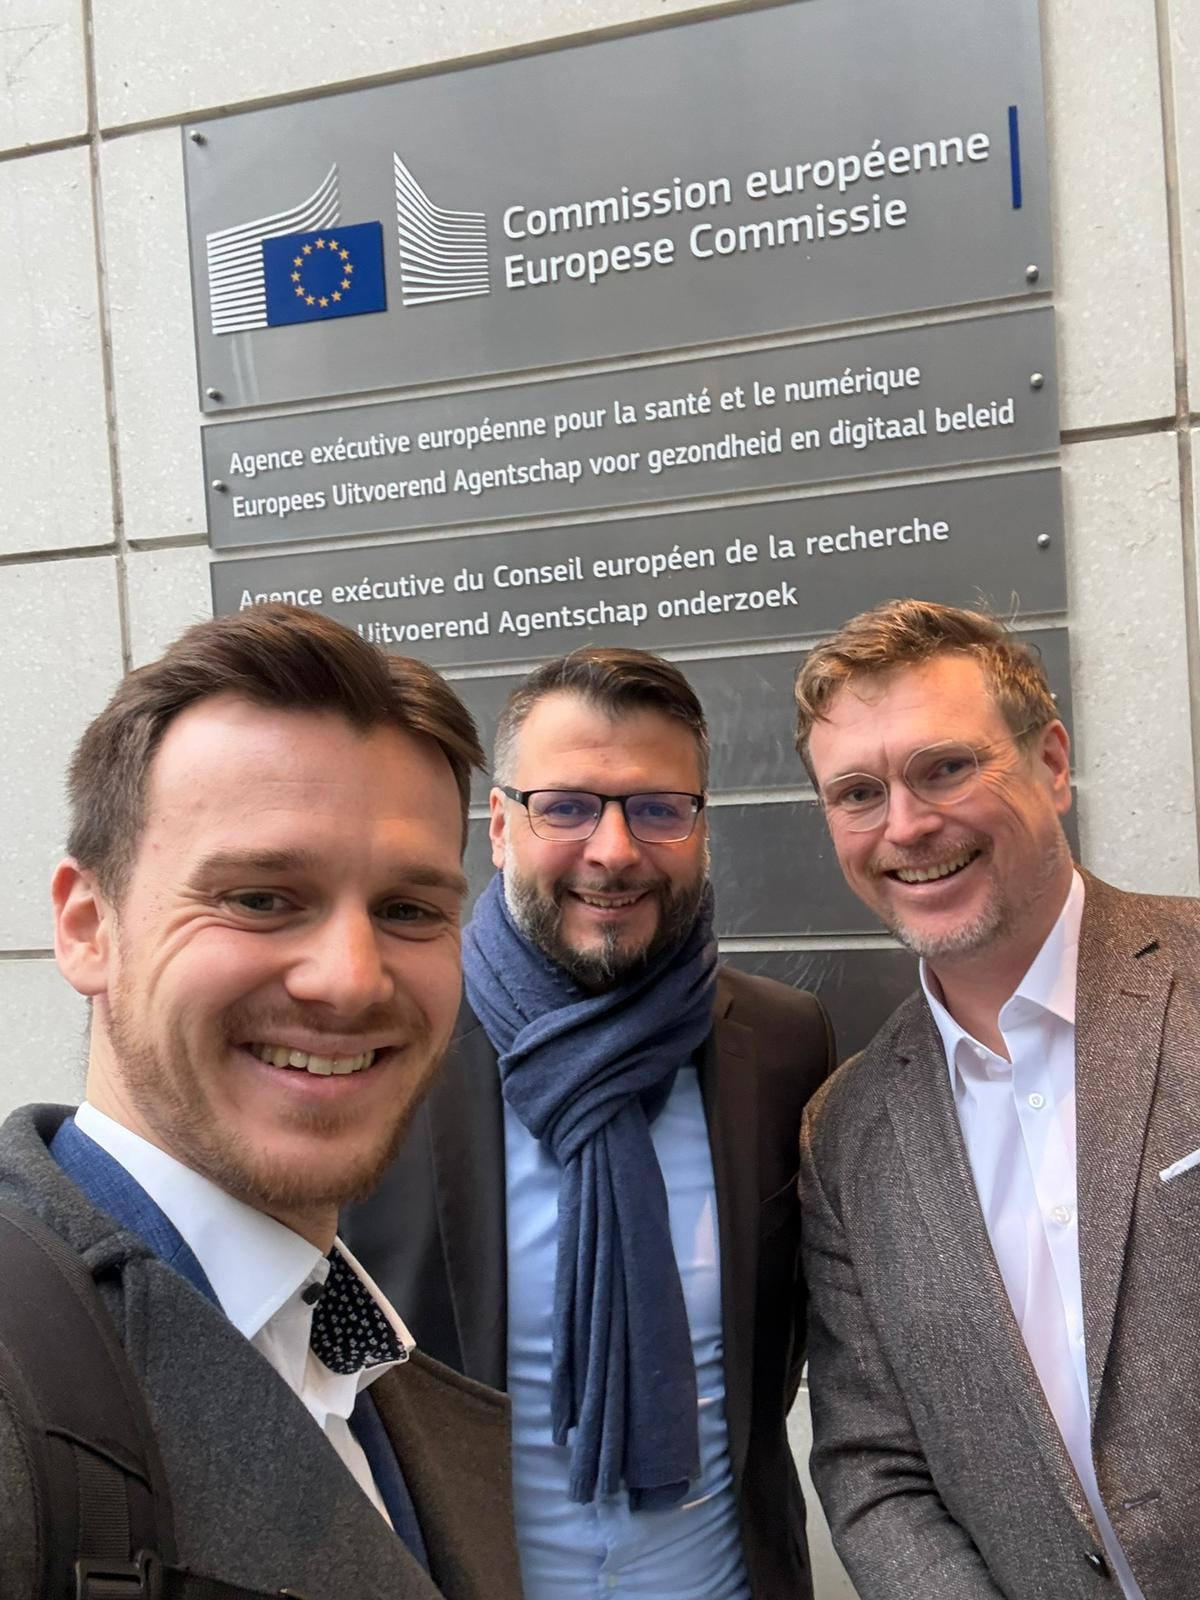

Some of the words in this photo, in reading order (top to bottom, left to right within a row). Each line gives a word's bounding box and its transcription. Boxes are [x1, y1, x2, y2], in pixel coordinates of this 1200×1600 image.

[503, 177, 732, 239] Commission
[746, 133, 990, 192] européenne
[504, 234, 674, 288] Europese
[689, 194, 906, 258] Commissie
[229, 449, 303, 478] Agence
[310, 433, 410, 464] exécutive
[417, 417, 546, 450] européenne
[554, 409, 607, 439] pour
[613, 400, 637, 425] la
[644, 387, 711, 421] santé
[719, 386, 746, 410] et
[753, 381, 776, 406] le
[784, 366, 921, 402] numérique
[232, 491, 326, 518] Europees
[332, 469, 446, 506] Uitvoerend
[453, 457, 582, 495] Agentschap
[588, 452, 641, 475] voor
[647, 427, 782, 474] gezondheid
[790, 429, 820, 450] en
[829, 409, 928, 449] digitaal
[935, 397, 1014, 433] beleid
[331, 574, 445, 603] exécutive
[453, 568, 484, 592] du
[493, 556, 584, 588] Conseil
[592, 544, 715, 578] européen
[725, 538, 758, 564] de
[768, 534, 796, 559] la
[806, 517, 949, 555] recherche
[357, 611, 489, 644] Uitvoerend
[498, 600, 648, 637] Agentschap
[657, 581, 798, 618] onderzoek
